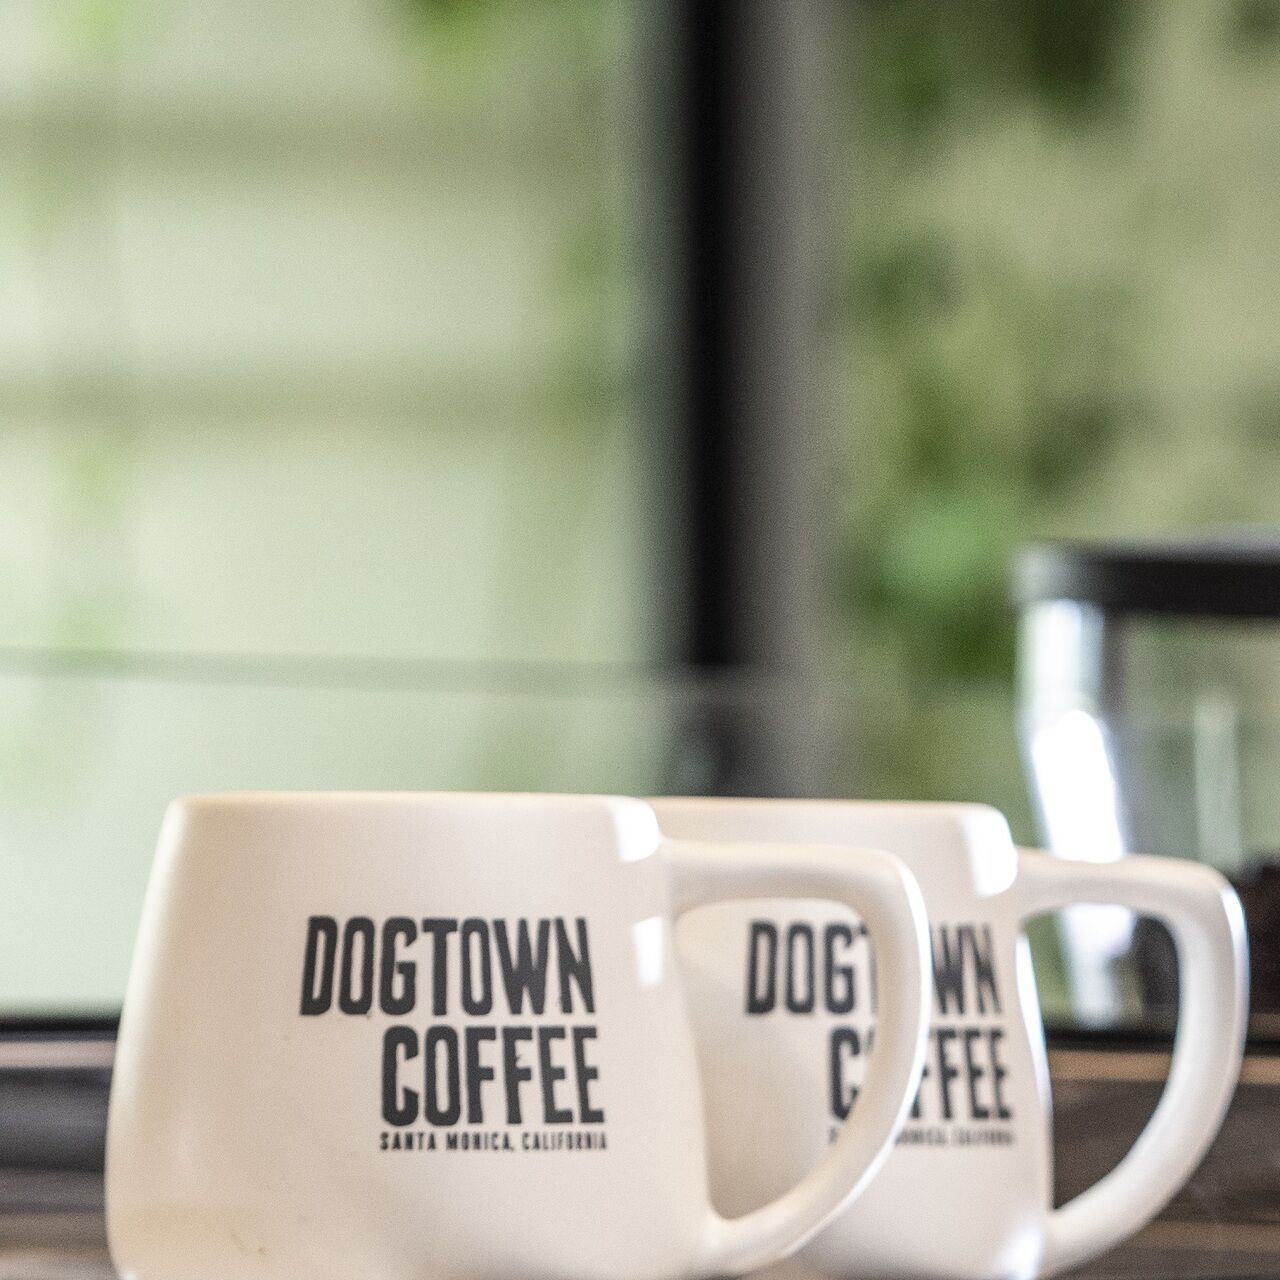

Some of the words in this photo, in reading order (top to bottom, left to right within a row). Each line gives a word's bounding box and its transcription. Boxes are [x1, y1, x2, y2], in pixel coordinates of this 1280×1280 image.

[299, 916, 595, 1016] DOGTOWN
[746, 921, 1002, 1016] DOGWN
[381, 1025, 605, 1127] COFFEE
[380, 1131, 436, 1151] SANTA
[446, 1131, 515, 1152] MONICA,
[522, 1131, 608, 1151] CALIFORNIA
